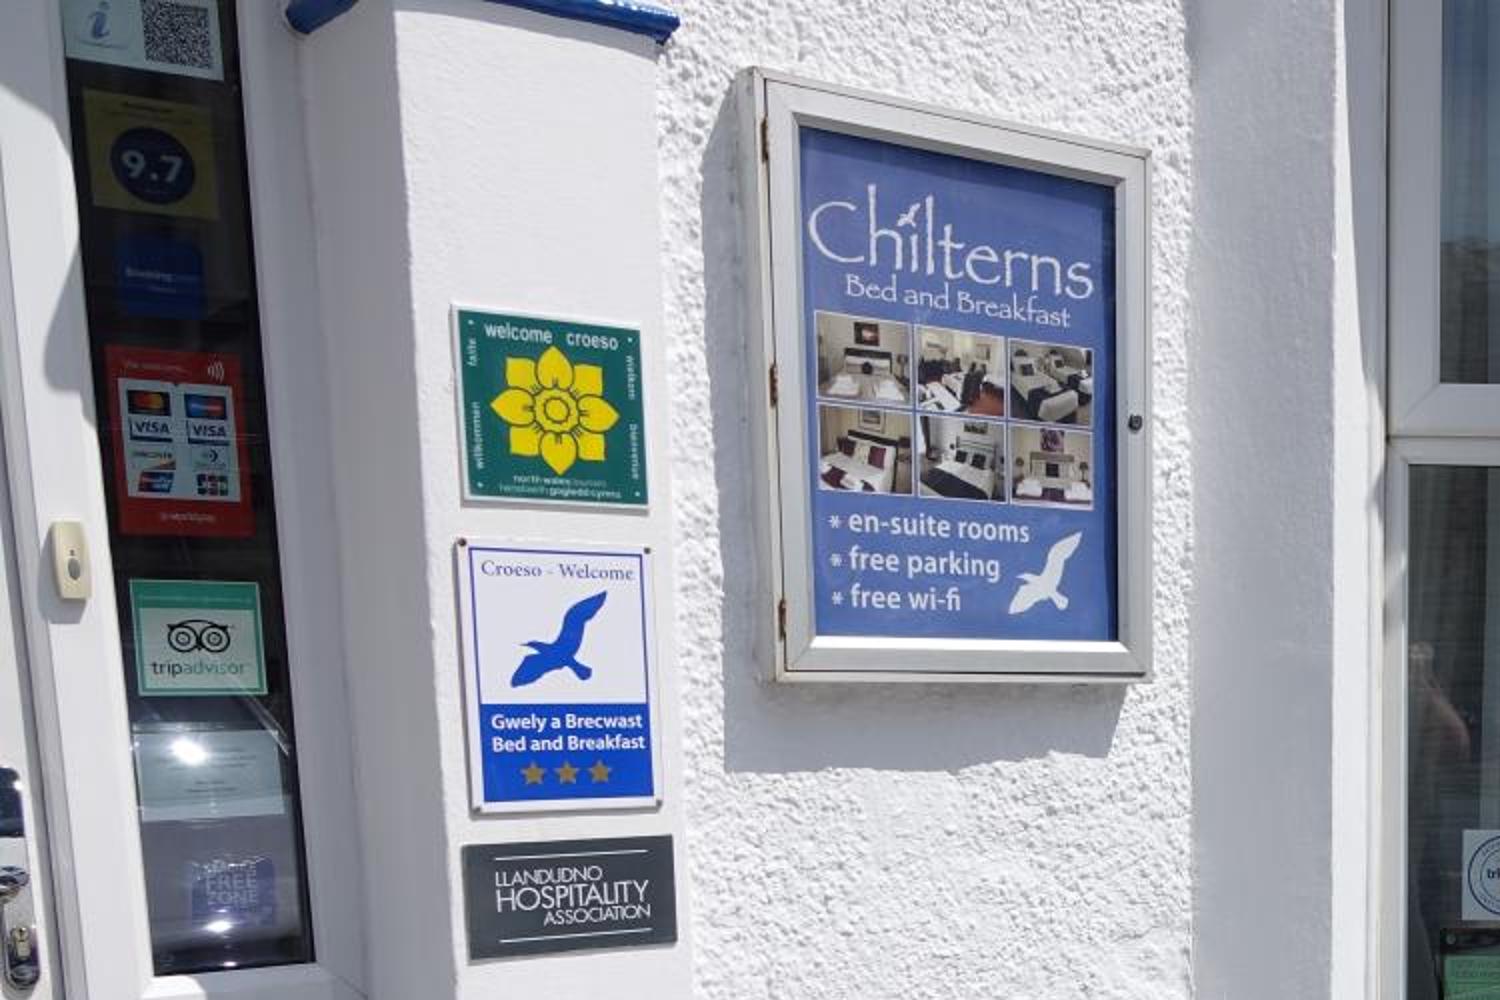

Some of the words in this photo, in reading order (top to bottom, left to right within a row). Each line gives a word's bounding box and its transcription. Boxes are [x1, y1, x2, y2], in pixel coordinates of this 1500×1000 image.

[121, 150, 183, 183] 9.7
[808, 183, 1095, 299] Chilterns
[845, 274, 897, 303] Bed
[904, 282, 949, 310] and
[957, 291, 1070, 328] Breakfast
[484, 321, 552, 344] welcome
[567, 331, 618, 351] croeso
[135, 420, 170, 435] VISA
[191, 423, 226, 438] VISA
[849, 513, 951, 538] en-suite
[958, 522, 1031, 543] rooms
[481, 560, 542, 578] Croeso
[559, 563, 633, 581] Welcome
[850, 545, 899, 571] free
[908, 551, 1000, 583] parking
[851, 584, 901, 609] free
[908, 587, 962, 611] wi-fi
[151, 660, 246, 678] tripadvisor
[491, 713, 547, 732] Gwely
[550, 718, 561, 728] a
[565, 713, 642, 729] Brecwast
[492, 736, 526, 752] Bed
[530, 735, 564, 751] and
[567, 735, 646, 751] Breakfast
[495, 865, 603, 887] LLANDUDNO
[496, 880, 649, 912] HOSPITALITY
[543, 904, 651, 926] ASSOCIATION
